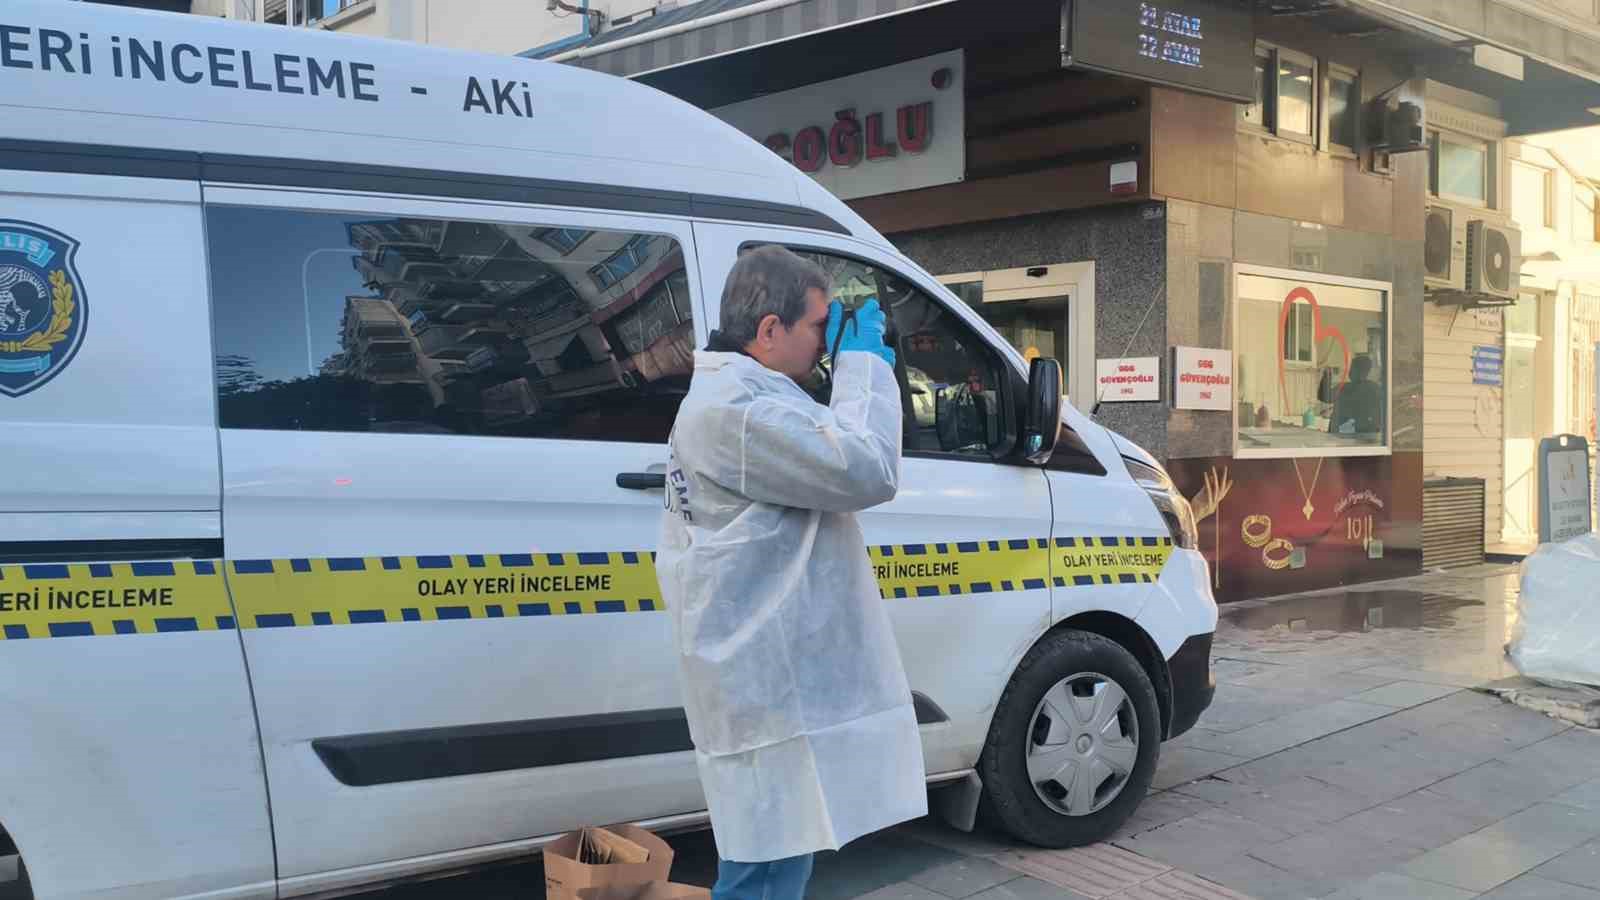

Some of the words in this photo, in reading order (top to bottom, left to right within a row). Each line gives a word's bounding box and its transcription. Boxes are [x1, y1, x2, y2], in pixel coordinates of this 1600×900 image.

[894, 561, 959, 578] İNCELEME
[1064, 553, 1092, 568] OLAY
[1094, 552, 1118, 566] YERİ
[1119, 552, 1162, 567] İNCELEME
[418, 579, 468, 596] OLAY
[473, 573, 515, 594] YERİ
[520, 573, 611, 593] İNCELEME
[48, 586, 173, 610] İNCELEME
